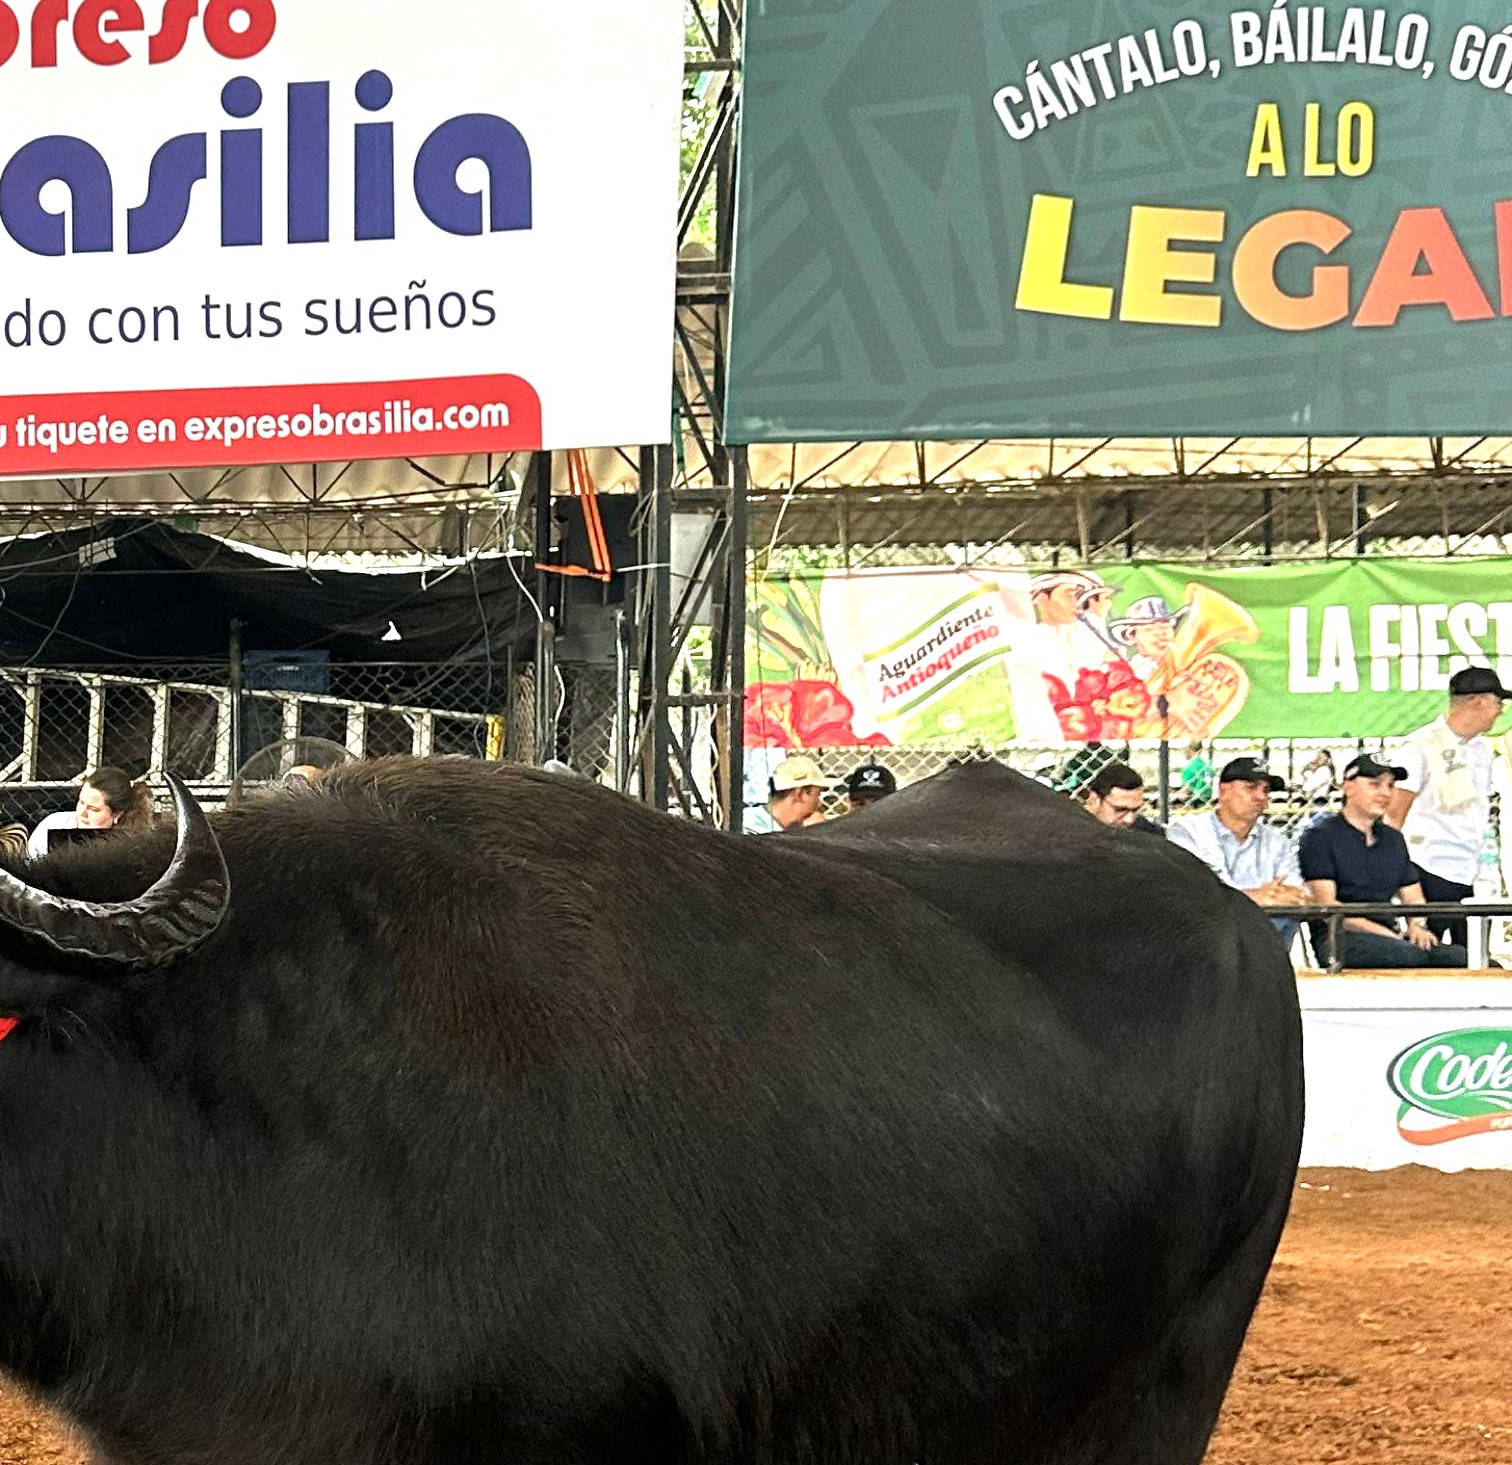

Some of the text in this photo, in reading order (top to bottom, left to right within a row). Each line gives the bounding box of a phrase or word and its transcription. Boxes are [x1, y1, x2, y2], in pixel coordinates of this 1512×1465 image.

[992, 18, 1221, 141] CÁNTALO,
[1231, 2, 1434, 80] BÁILALO,
[1246, 102, 1375, 177] A LO
[88, 303, 179, 345] con
[202, 293, 283, 340] tus
[304, 280, 496, 336] sueños
[16, 416, 130, 453] tiquete
[137, 418, 177, 443] en
[184, 400, 510, 446] expresobrasilia.com
[879, 606, 994, 681] Aguardiente
[881, 625, 999, 703] Antioqueño
[1289, 606, 1359, 693] LA
